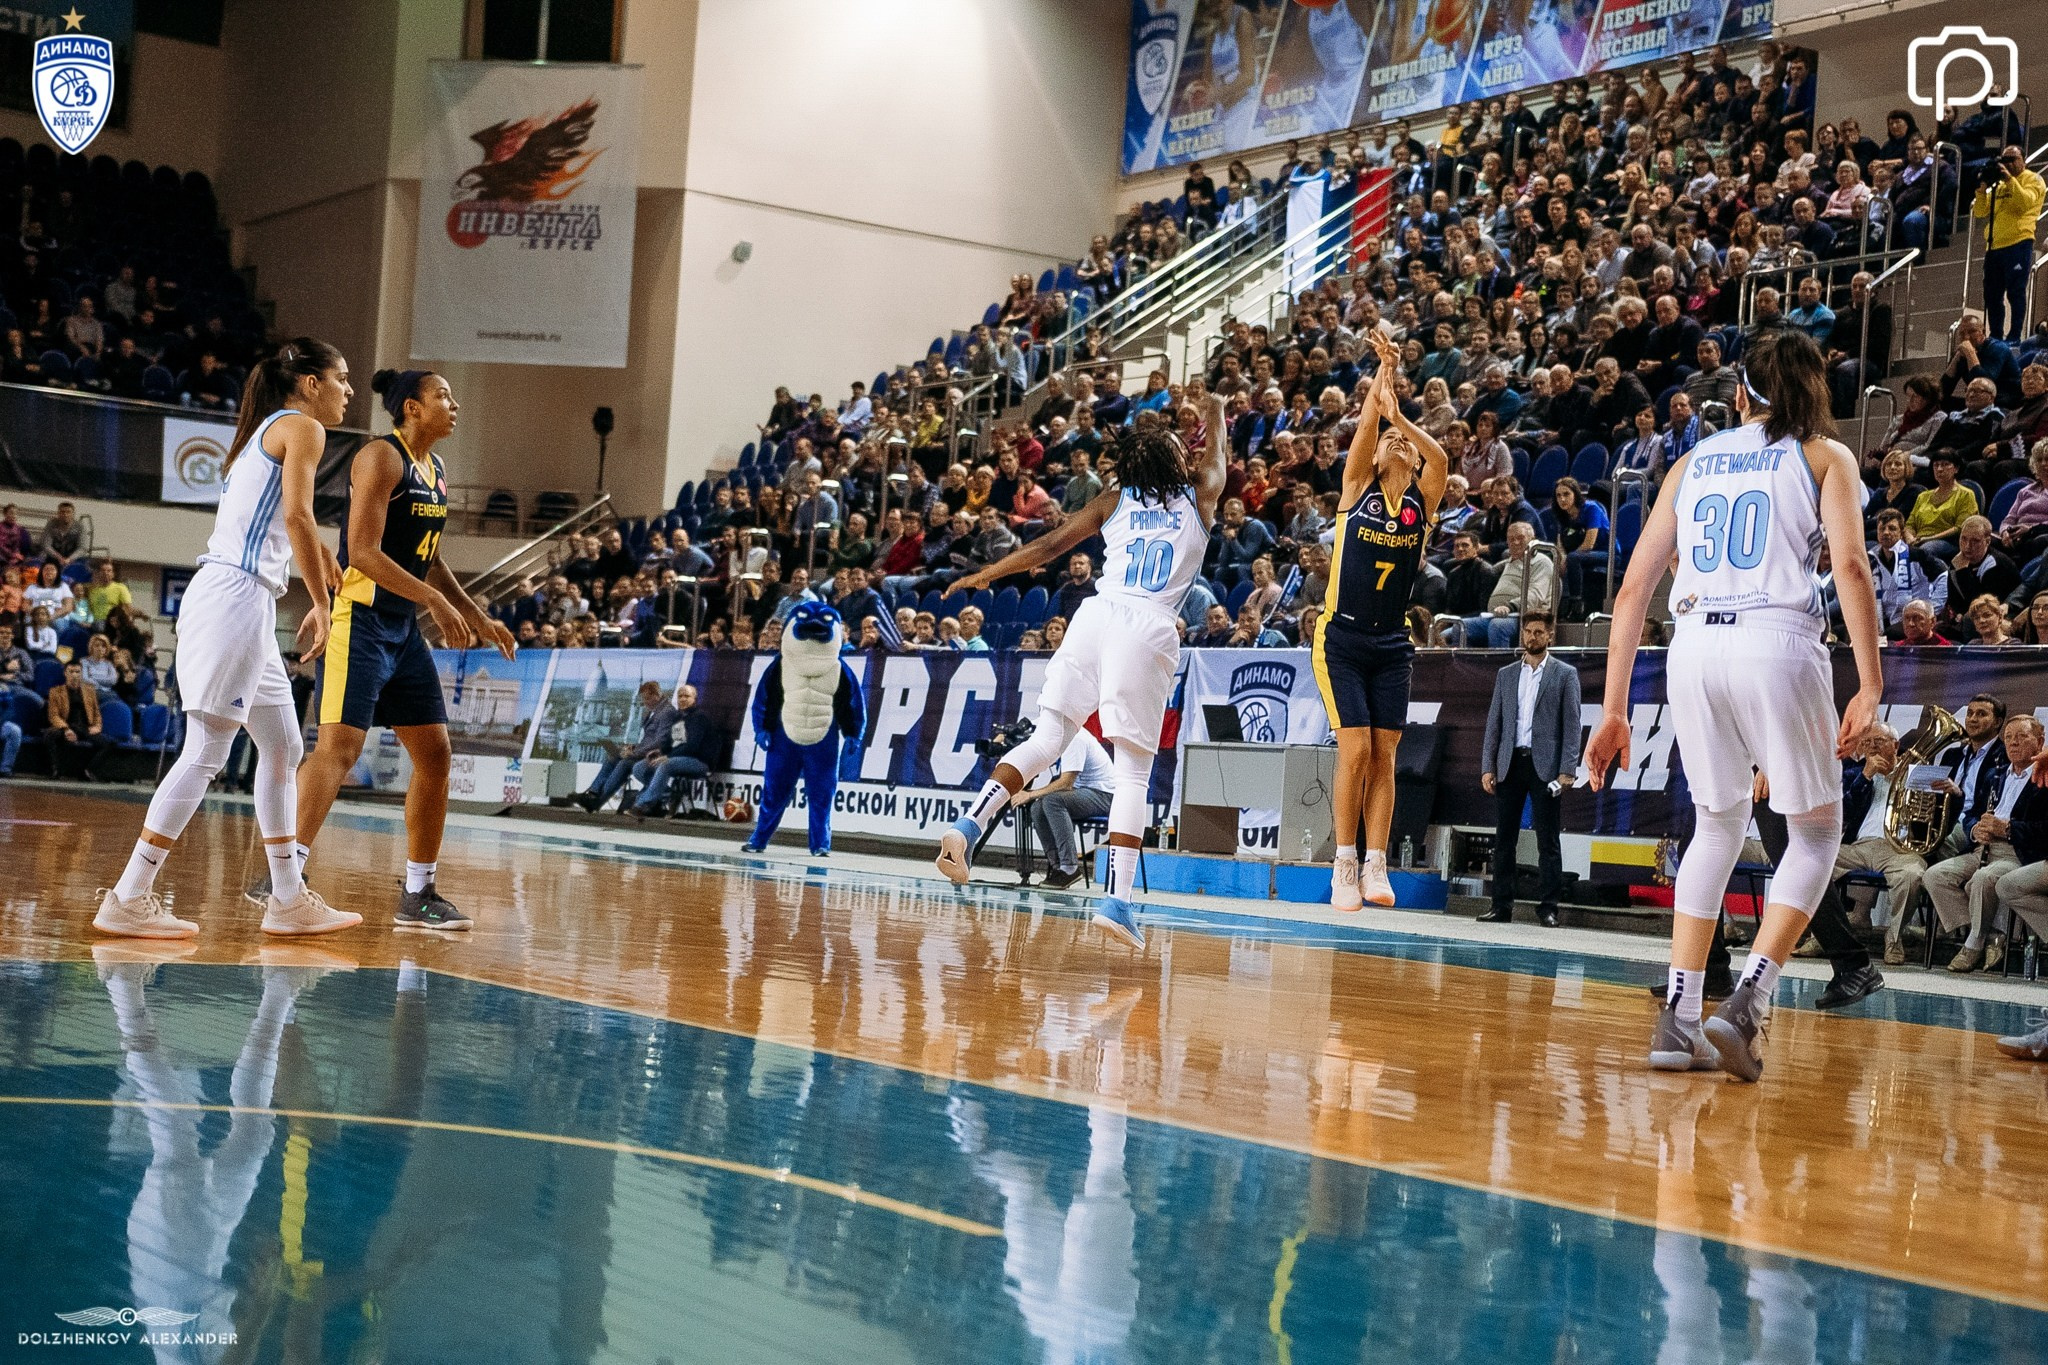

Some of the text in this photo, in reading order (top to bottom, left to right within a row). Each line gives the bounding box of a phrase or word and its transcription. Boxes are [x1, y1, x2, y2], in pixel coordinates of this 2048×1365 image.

[1602, 0, 1691, 32] ЛЕВЧЕНКО
[1483, 35, 1524, 61] КРУЗ
[1600, 27, 1669, 61] КСЕНИЯ
[1370, 51, 1458, 87] КИРИЛЛОВА
[1481, 63, 1525, 88] АННА
[456, 211, 602, 240] ИНВЕНТА
[1693, 448, 1787, 480] STEWART
[1130, 511, 1183, 531] PRINCE
[1693, 490, 1771, 574] 30
[416, 530, 440, 561] 41
[1357, 526, 1419, 549] FENERBAHÇE
[1124, 537, 1174, 593] 10
[1375, 560, 1396, 591] 7
[1232, 666, 1292, 692] ДИНАМО
